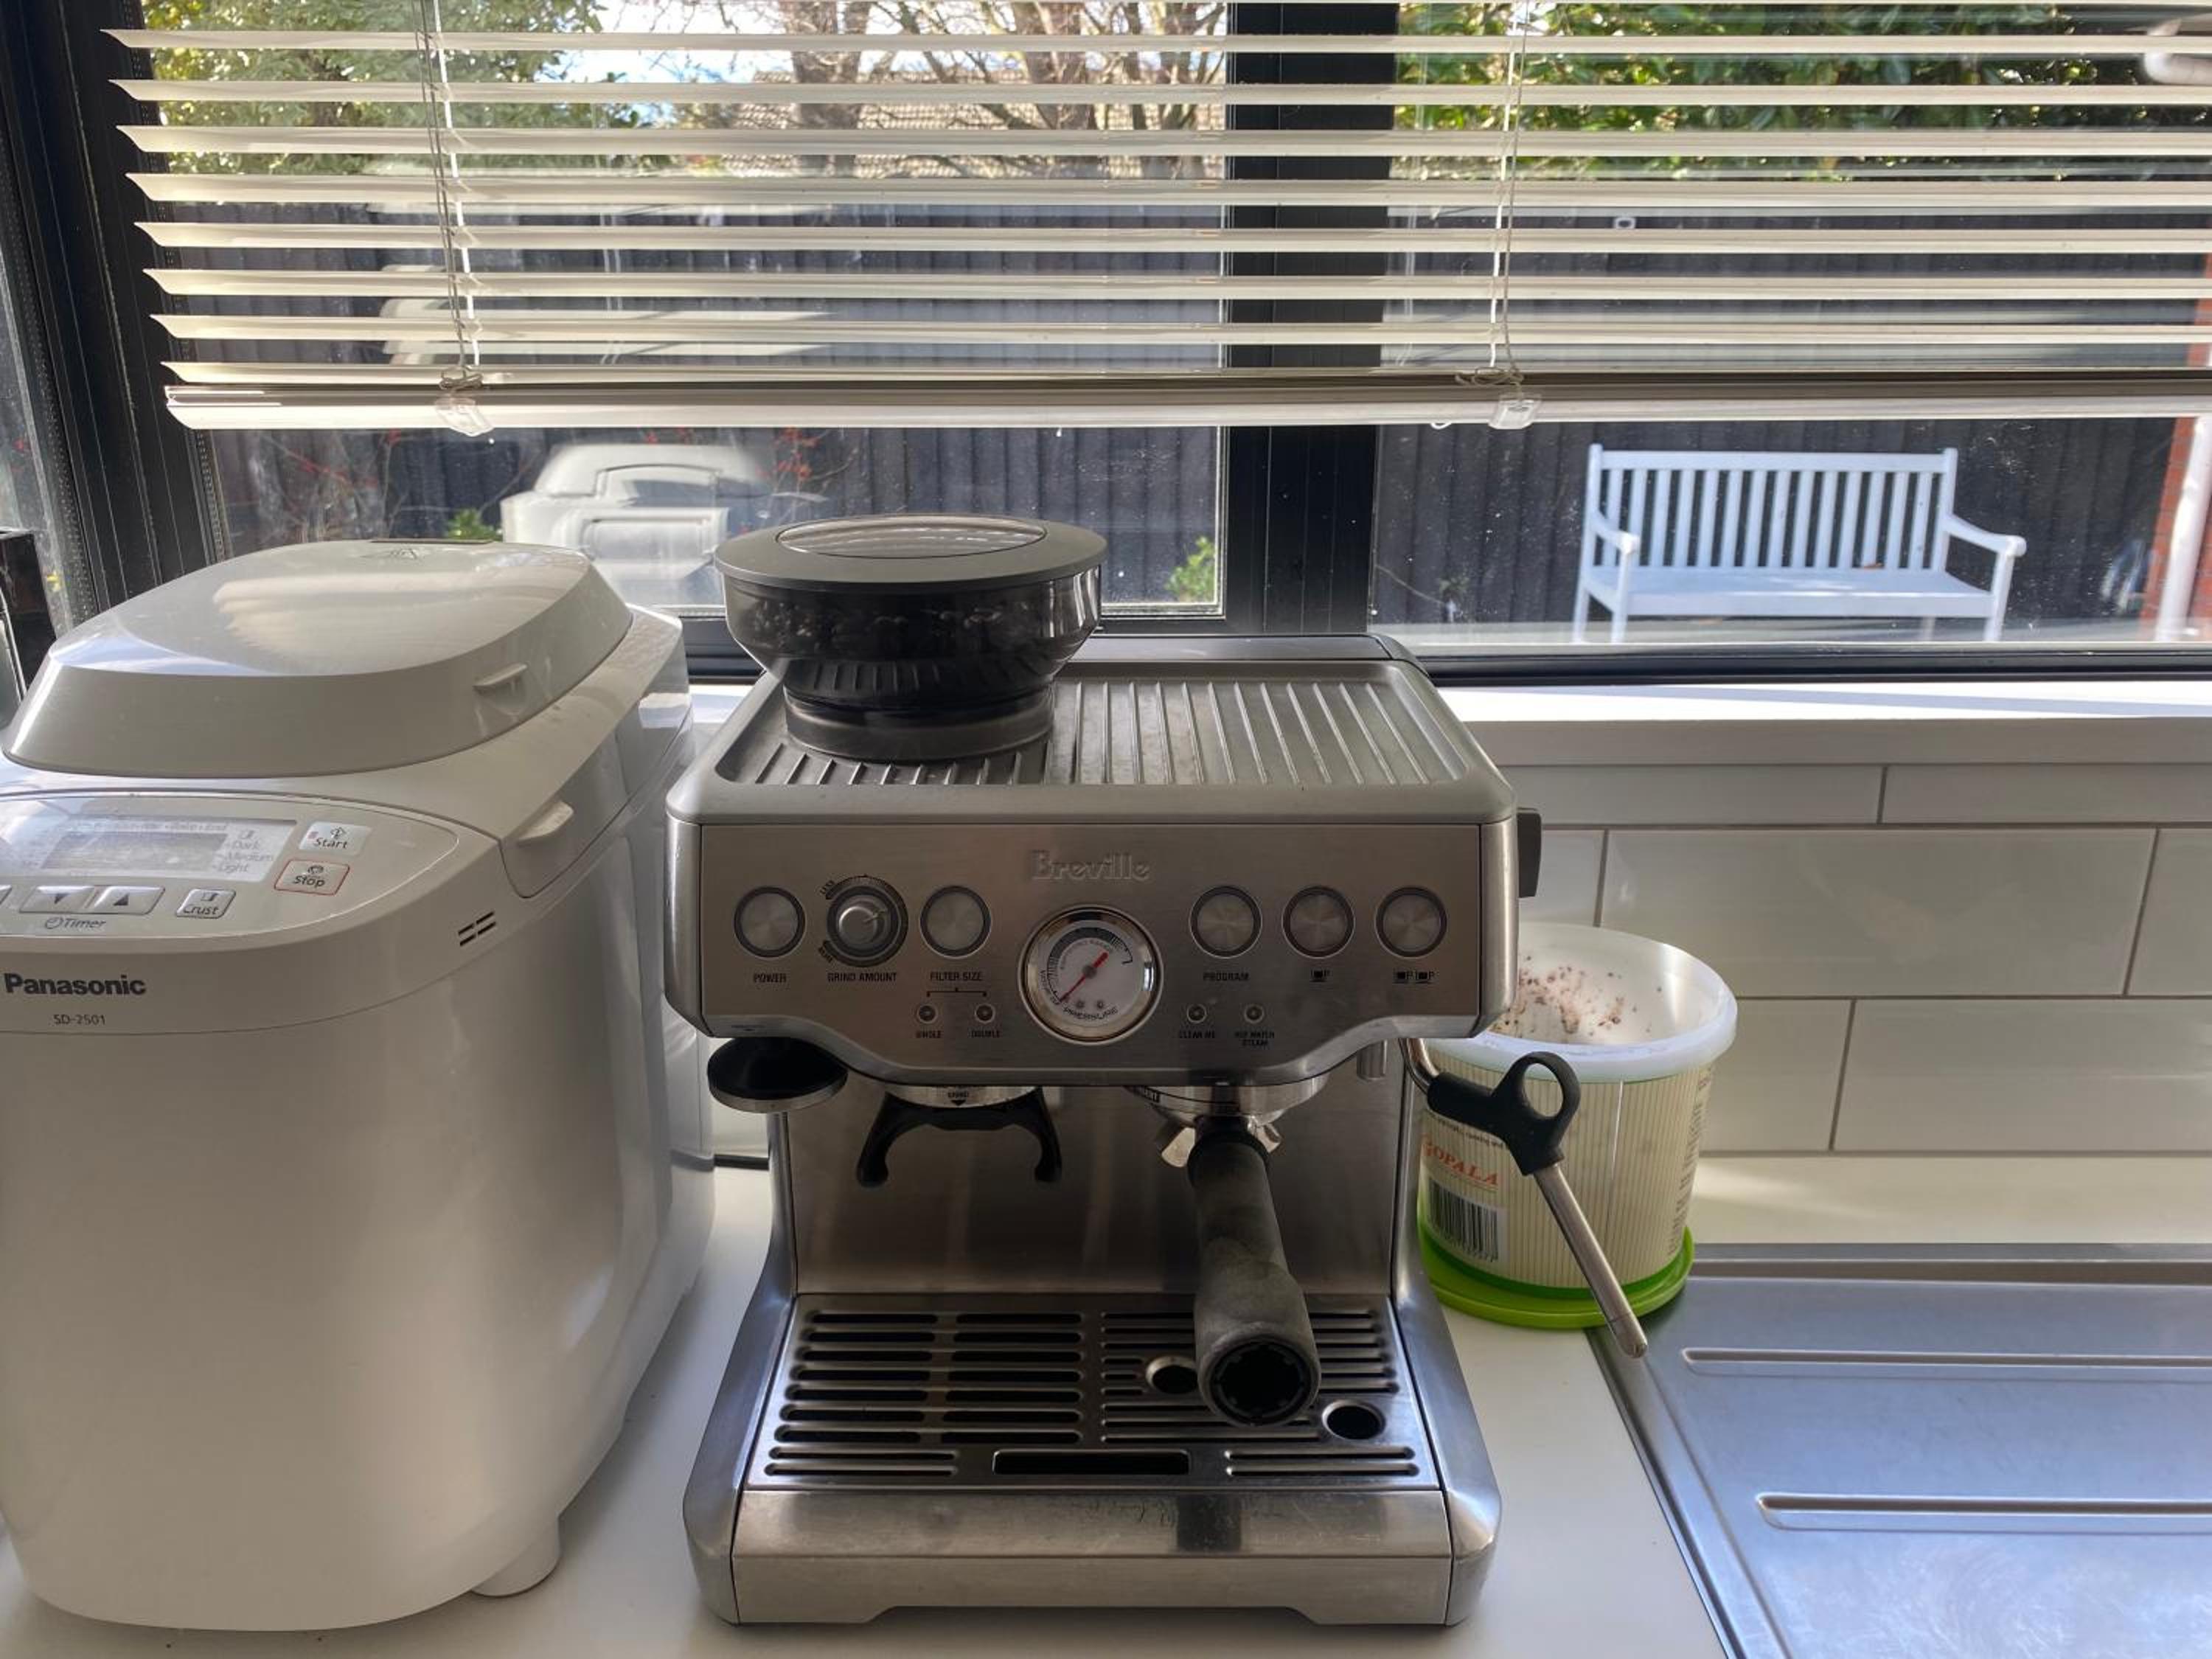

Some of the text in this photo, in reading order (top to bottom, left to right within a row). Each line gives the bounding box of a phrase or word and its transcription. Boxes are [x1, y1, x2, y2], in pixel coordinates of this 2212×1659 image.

[313, 837, 348, 849] Start
[1032, 849, 1151, 882] Breville
[294, 875, 326, 888] Stop
[184, 904, 220, 916] Crust
[64, 917, 106, 928] Timer
[754, 973, 787, 983] POWER
[827, 973, 897, 982] GRIND AMOUNT
[930, 972, 982, 981] FILTER SIZE
[1203, 972, 1250, 981] PROGRAM
[4, 973, 147, 995] Panasonic
[54, 1014, 105, 1026] SD-2501
